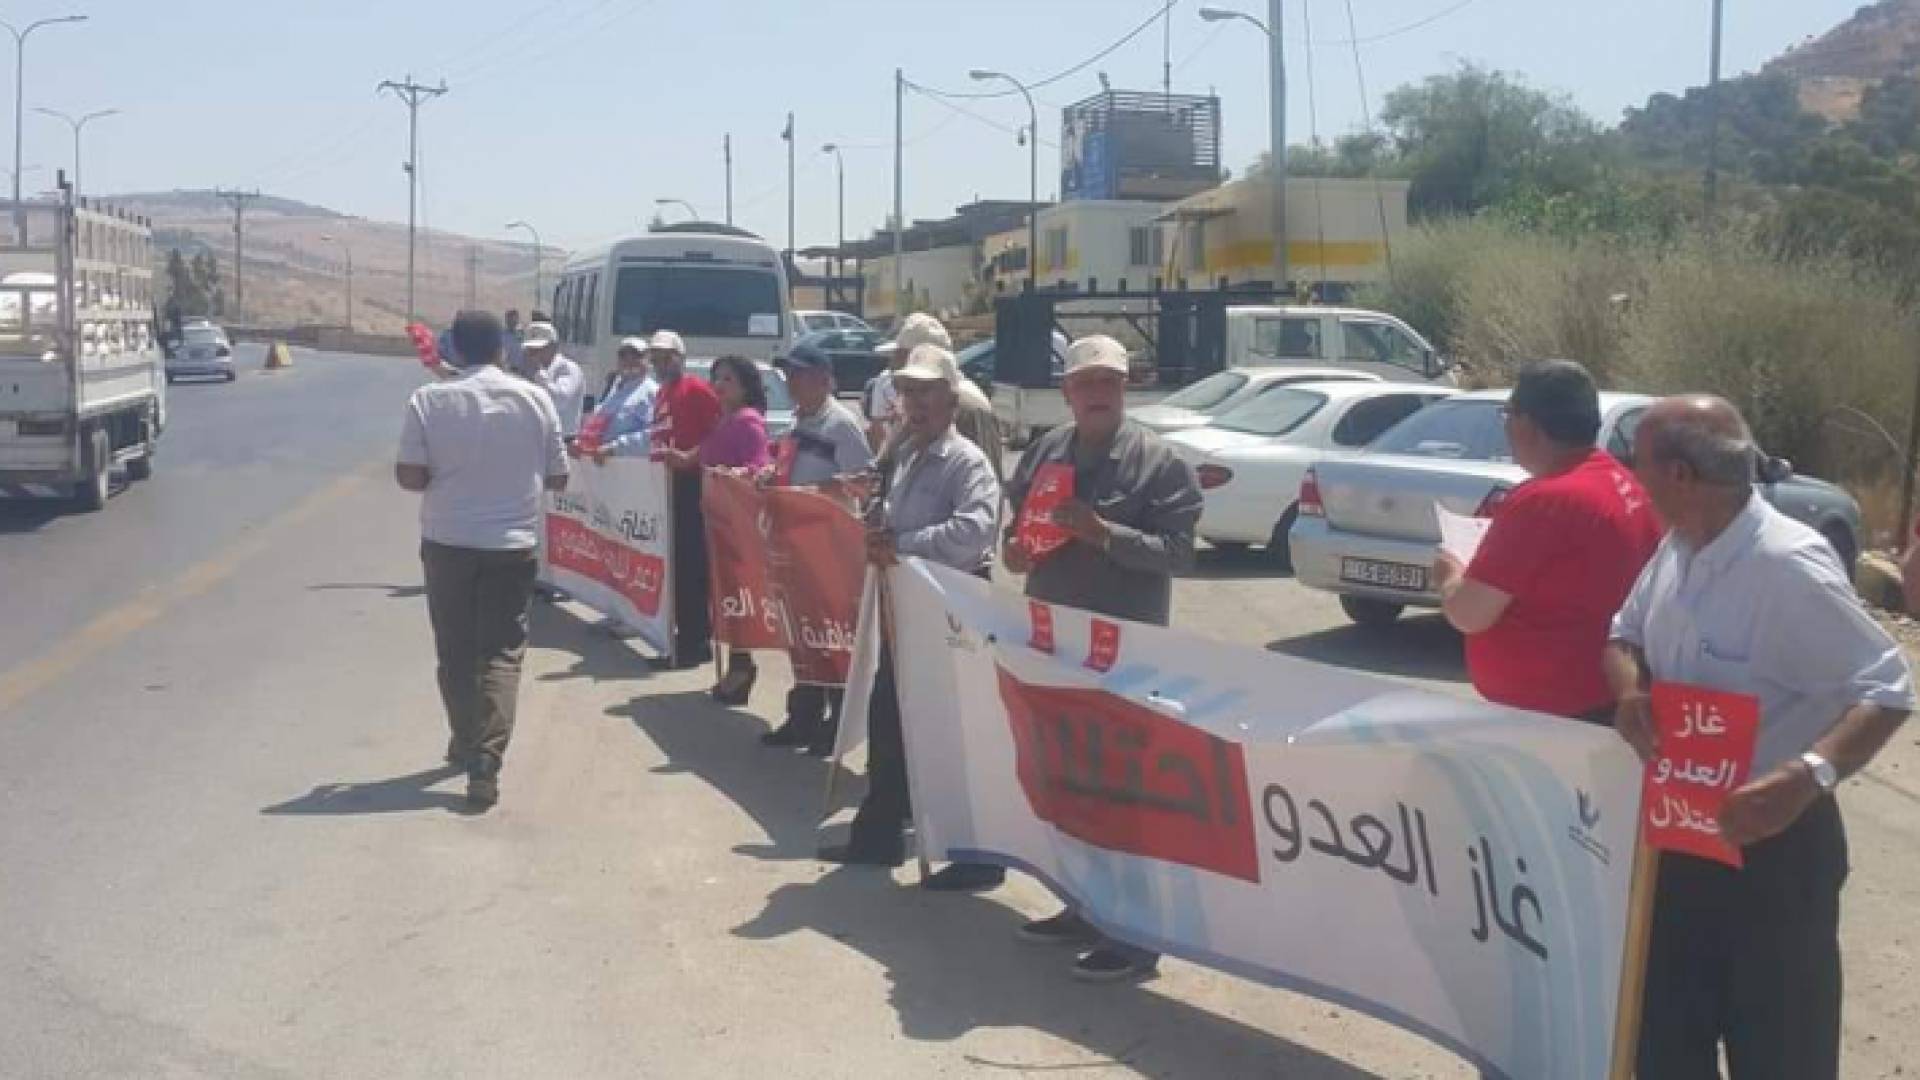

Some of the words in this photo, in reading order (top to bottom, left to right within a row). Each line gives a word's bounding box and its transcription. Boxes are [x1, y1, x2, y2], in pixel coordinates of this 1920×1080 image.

[1672, 701, 1727, 738] غاز
[1652, 758, 1738, 789] العدو
[1650, 795, 1721, 835] حتلال
[1263, 783, 1438, 897] العدو
[1468, 836, 1548, 961] غاز
